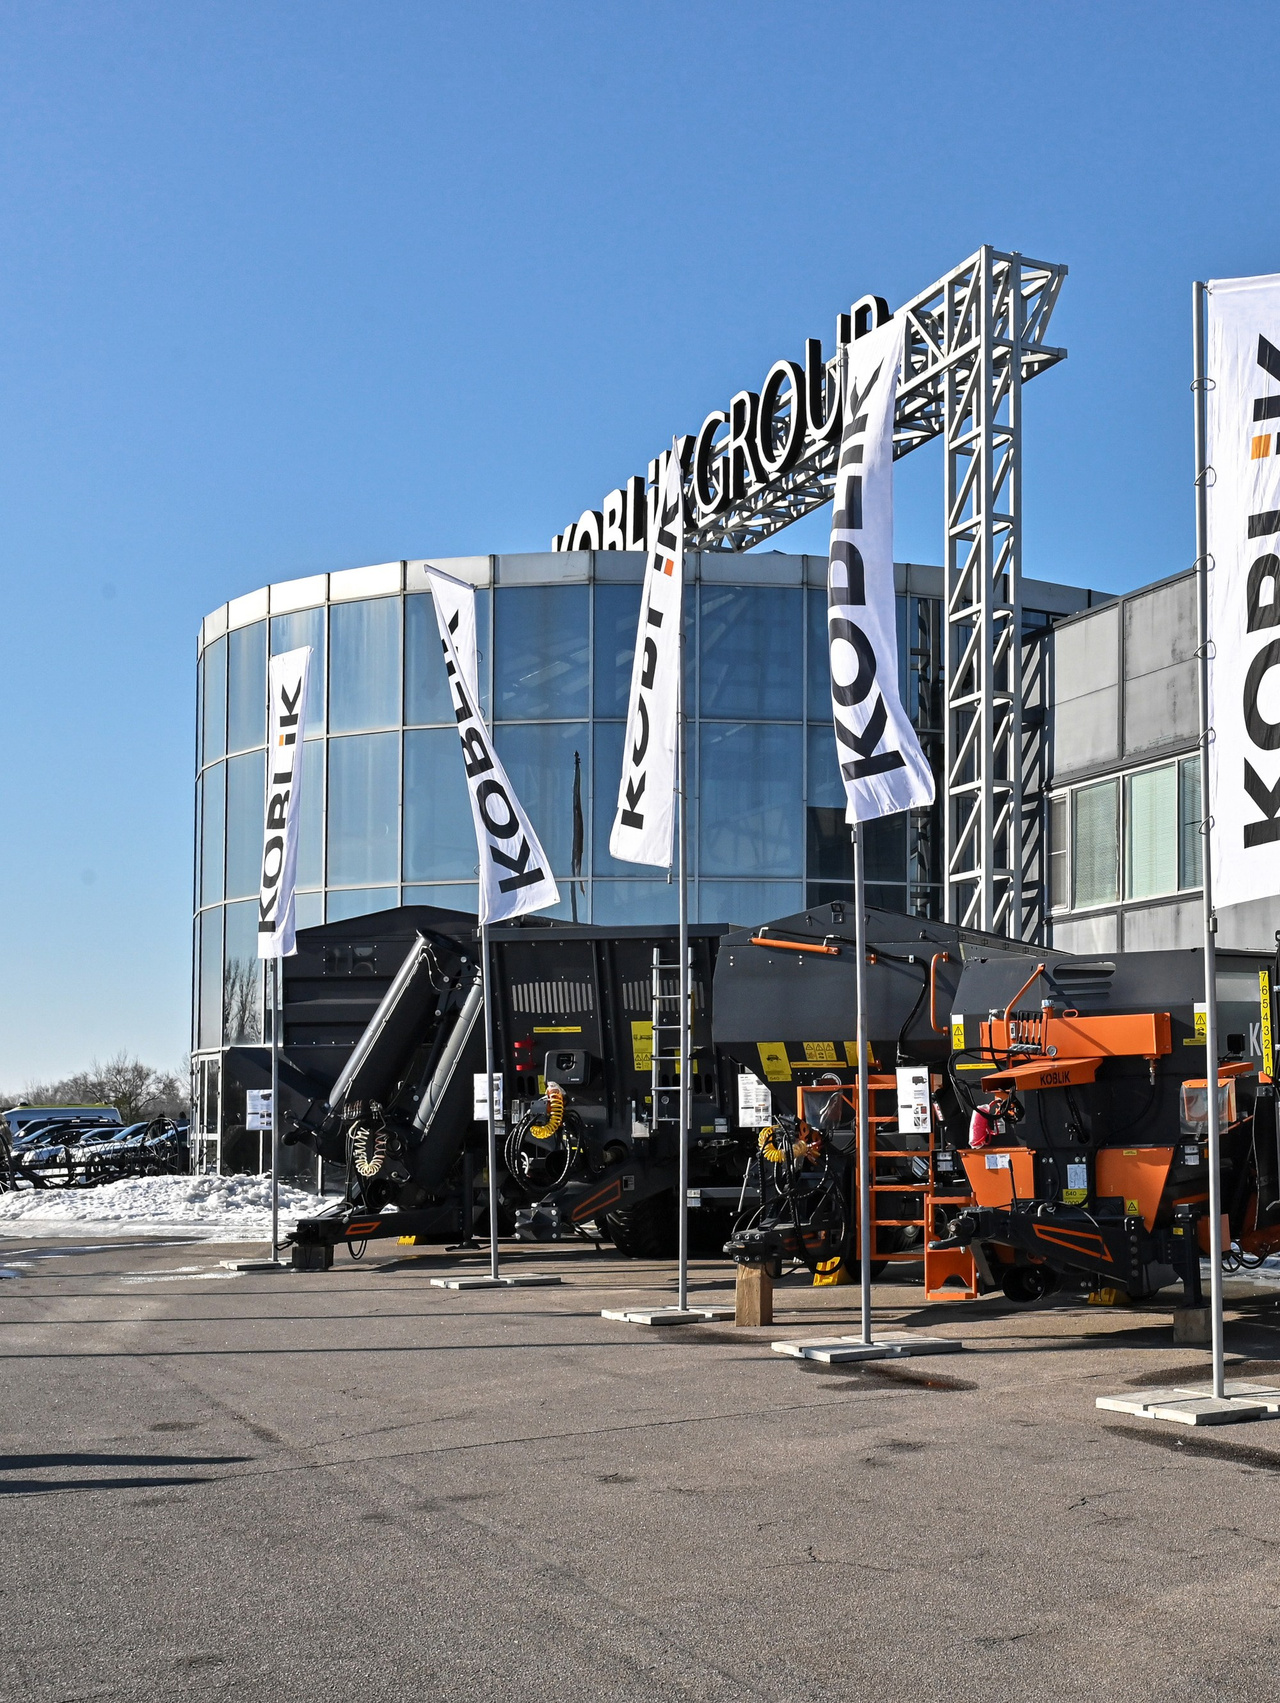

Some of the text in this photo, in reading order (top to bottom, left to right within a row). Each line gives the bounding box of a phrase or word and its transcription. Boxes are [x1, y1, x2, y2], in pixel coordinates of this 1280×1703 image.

[441, 608, 546, 894] KOBL
[1261, 972, 1267, 982] 7
[1261, 985, 1268, 995] 6
[1262, 999, 1269, 1009] 5
[1262, 1012, 1269, 1022] 4
[1263, 1025, 1270, 1036] 3
[1264, 1039, 1270, 1050] 2
[1265, 1053, 1270, 1062] 1
[1265, 1066, 1272, 1076] 0
